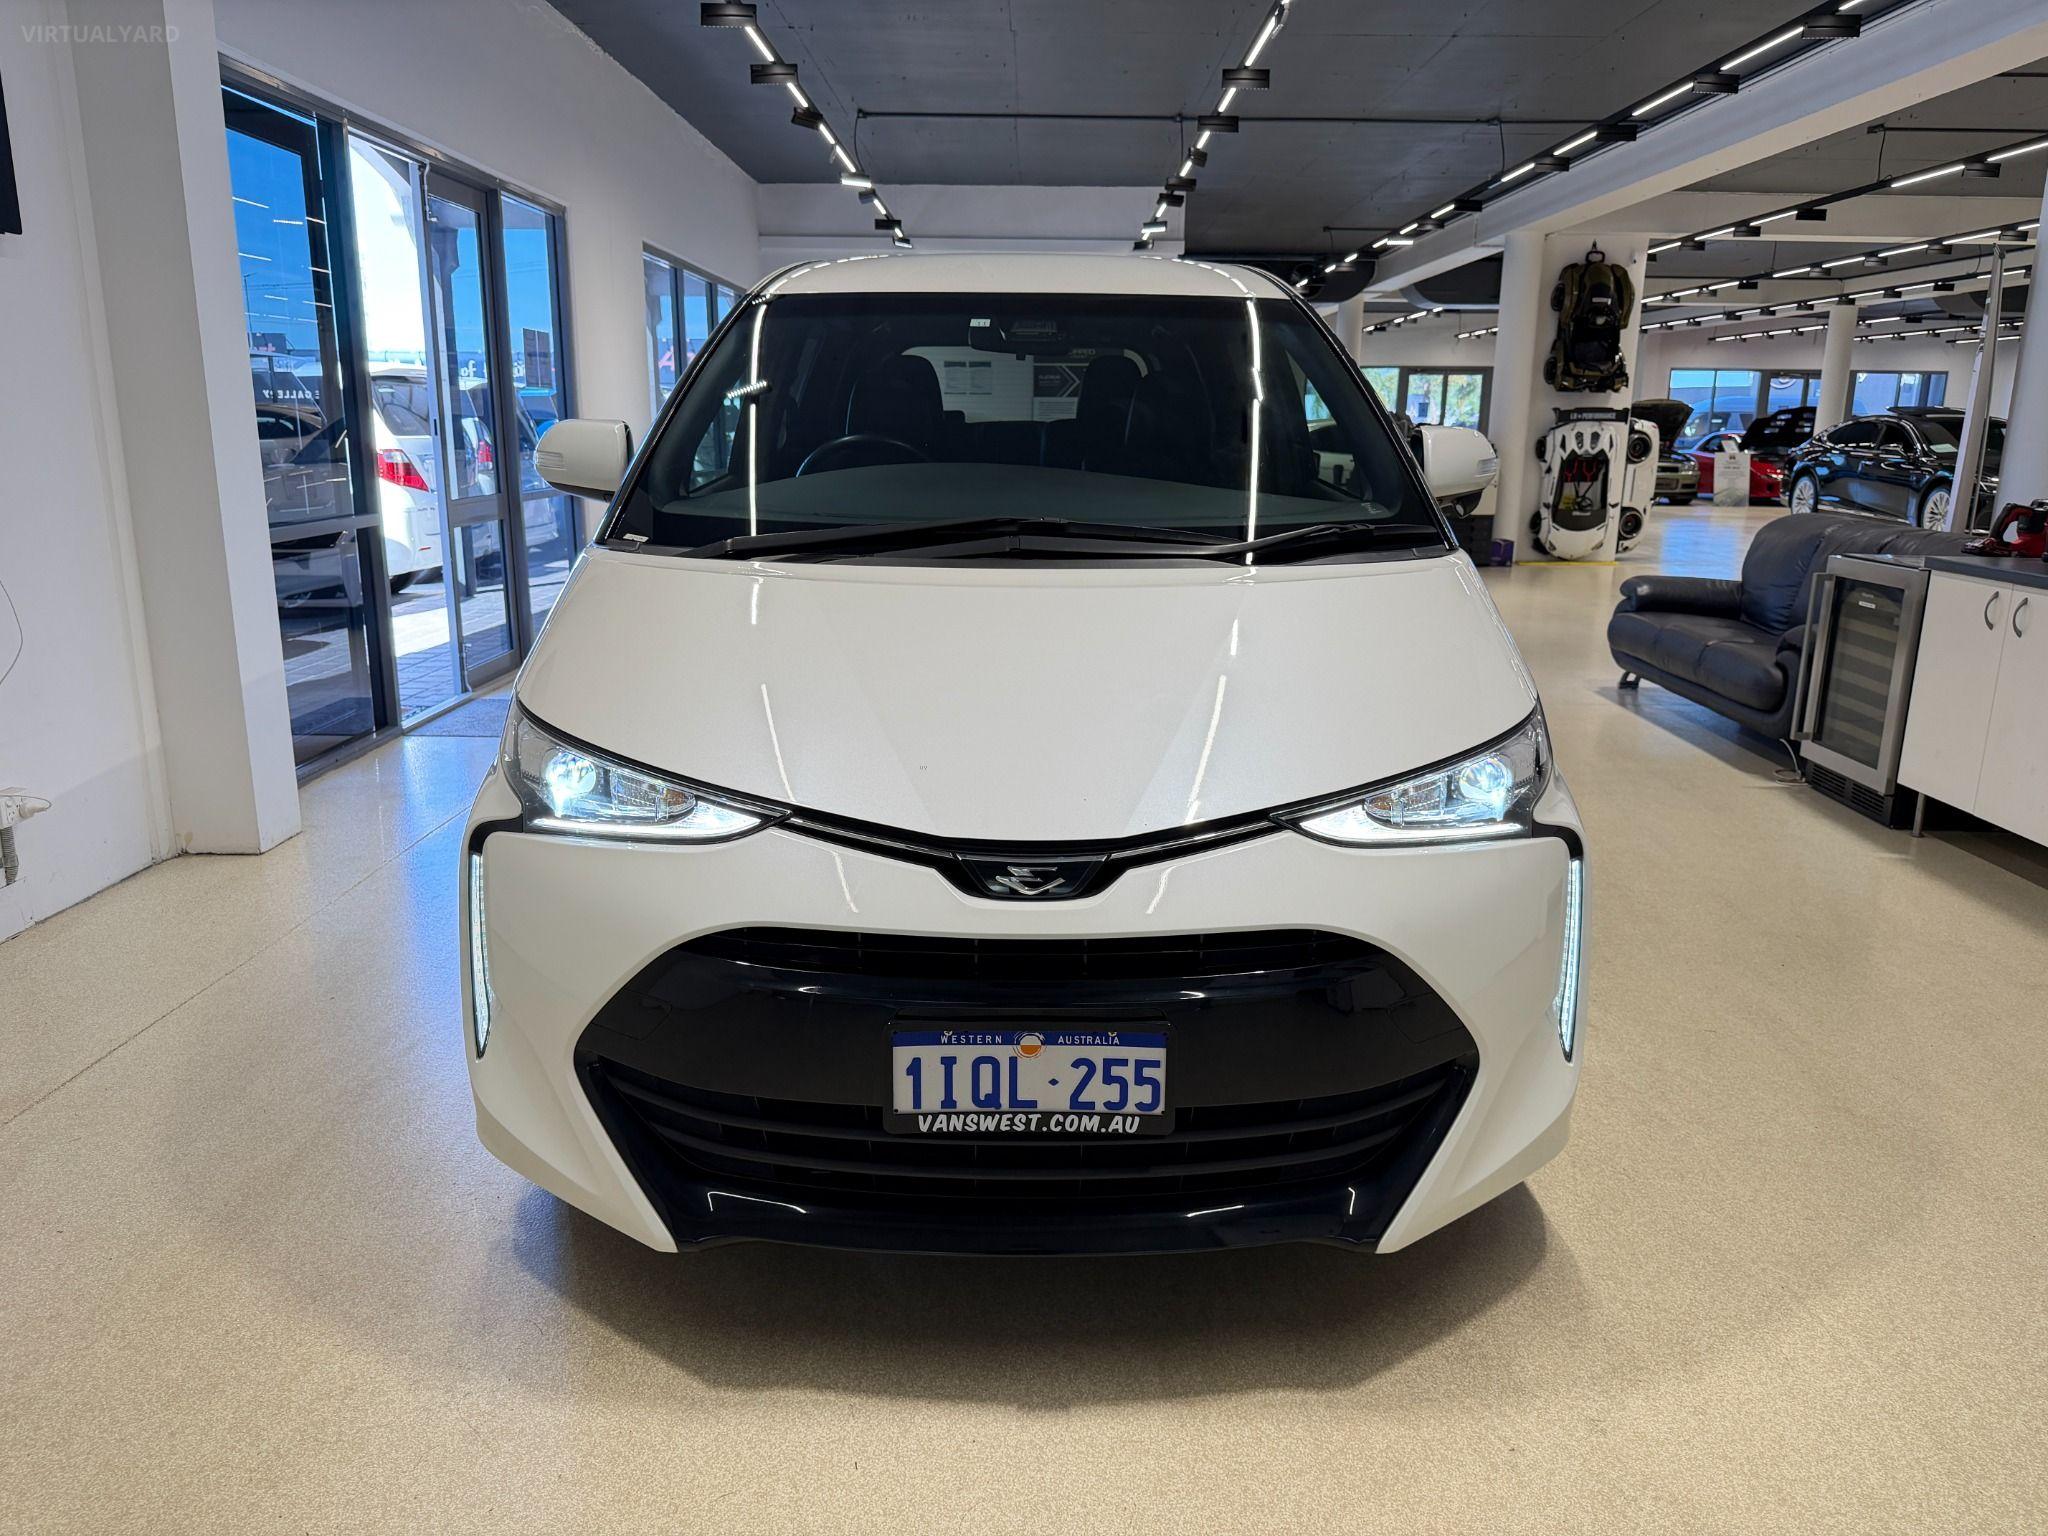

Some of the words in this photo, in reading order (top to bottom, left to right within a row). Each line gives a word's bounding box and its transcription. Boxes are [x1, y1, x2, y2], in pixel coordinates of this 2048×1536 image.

[940, 1033, 1003, 1045] WESTERN
[1057, 1035, 1120, 1045] AUSTRALIA
[918, 1113, 1141, 1133] VANSWEST.COM.AU
